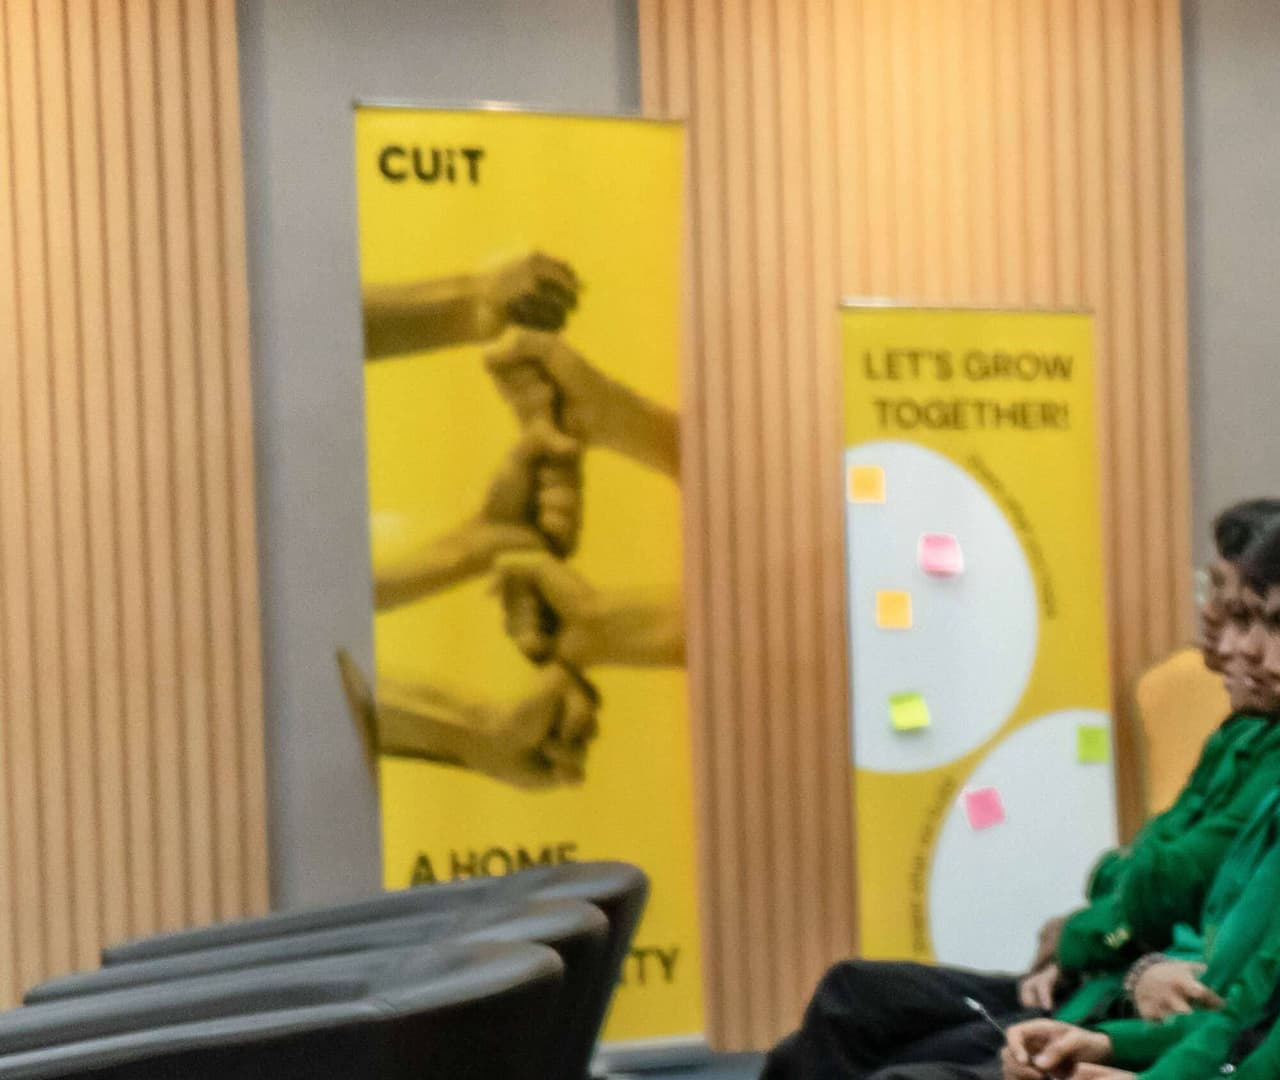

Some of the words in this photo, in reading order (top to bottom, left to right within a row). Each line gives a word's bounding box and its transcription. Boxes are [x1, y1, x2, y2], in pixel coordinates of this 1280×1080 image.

[963, 351, 1074, 382] GROW
[874, 398, 1070, 432] TOGETHER!
[409, 850, 437, 886] A
